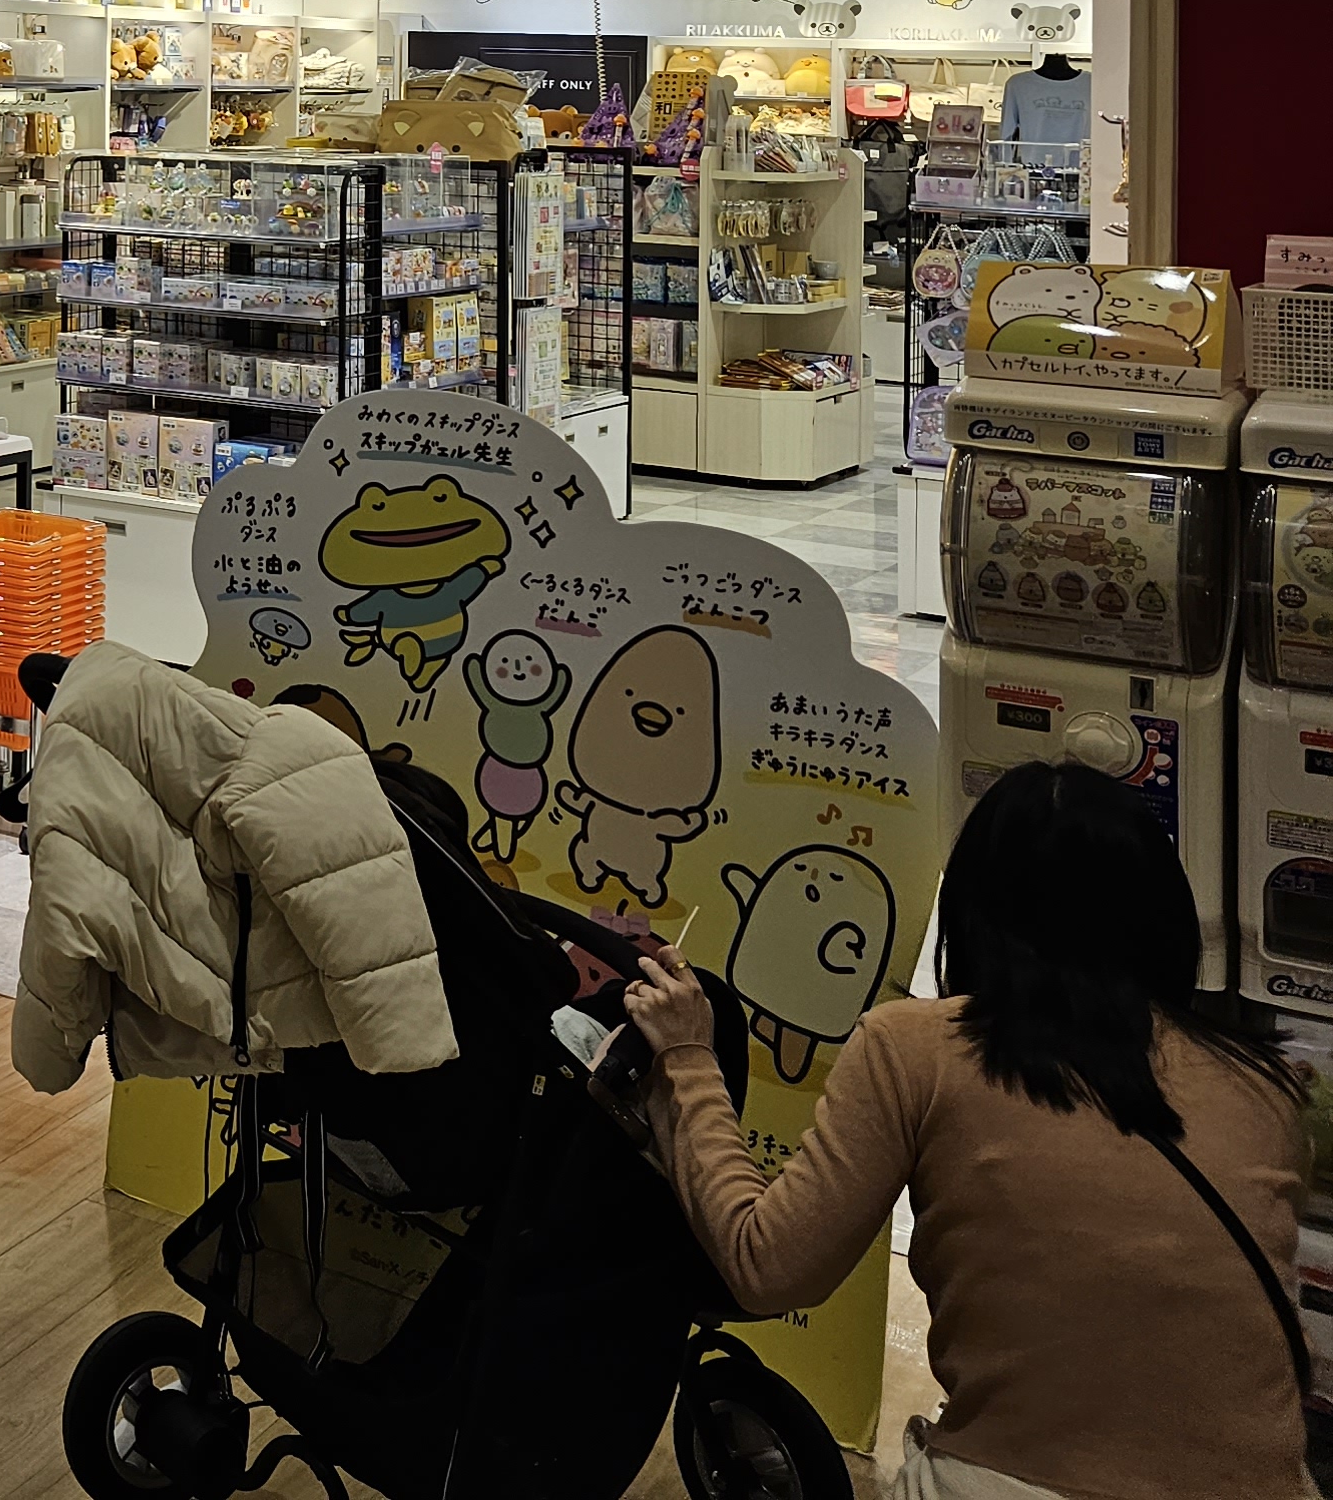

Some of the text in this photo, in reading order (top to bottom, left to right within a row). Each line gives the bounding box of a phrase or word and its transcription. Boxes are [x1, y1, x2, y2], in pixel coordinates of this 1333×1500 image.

[559, 80, 593, 91] ONLY
[360, 432, 514, 468] スキップガエル先生
[1136, 447, 1161, 455] ARTS
[1137, 441, 1161, 449] TOMY
[1025, 478, 1126, 501] ラバーマスコット
[221, 490, 298, 518] ぷるぷる
[240, 520, 278, 544] ダンス
[213, 554, 301, 575] 水と油の
[225, 576, 290, 596] ようせい
[537, 600, 608, 630] だんご
[681, 593, 770, 626] なんこつ
[769, 691, 893, 734] あまいうた声
[1006, 711, 1043, 725] ¥300
[769, 722, 890, 761] キラキラダンス
[750, 747, 911, 799] ぎゅうにゅうアイス
